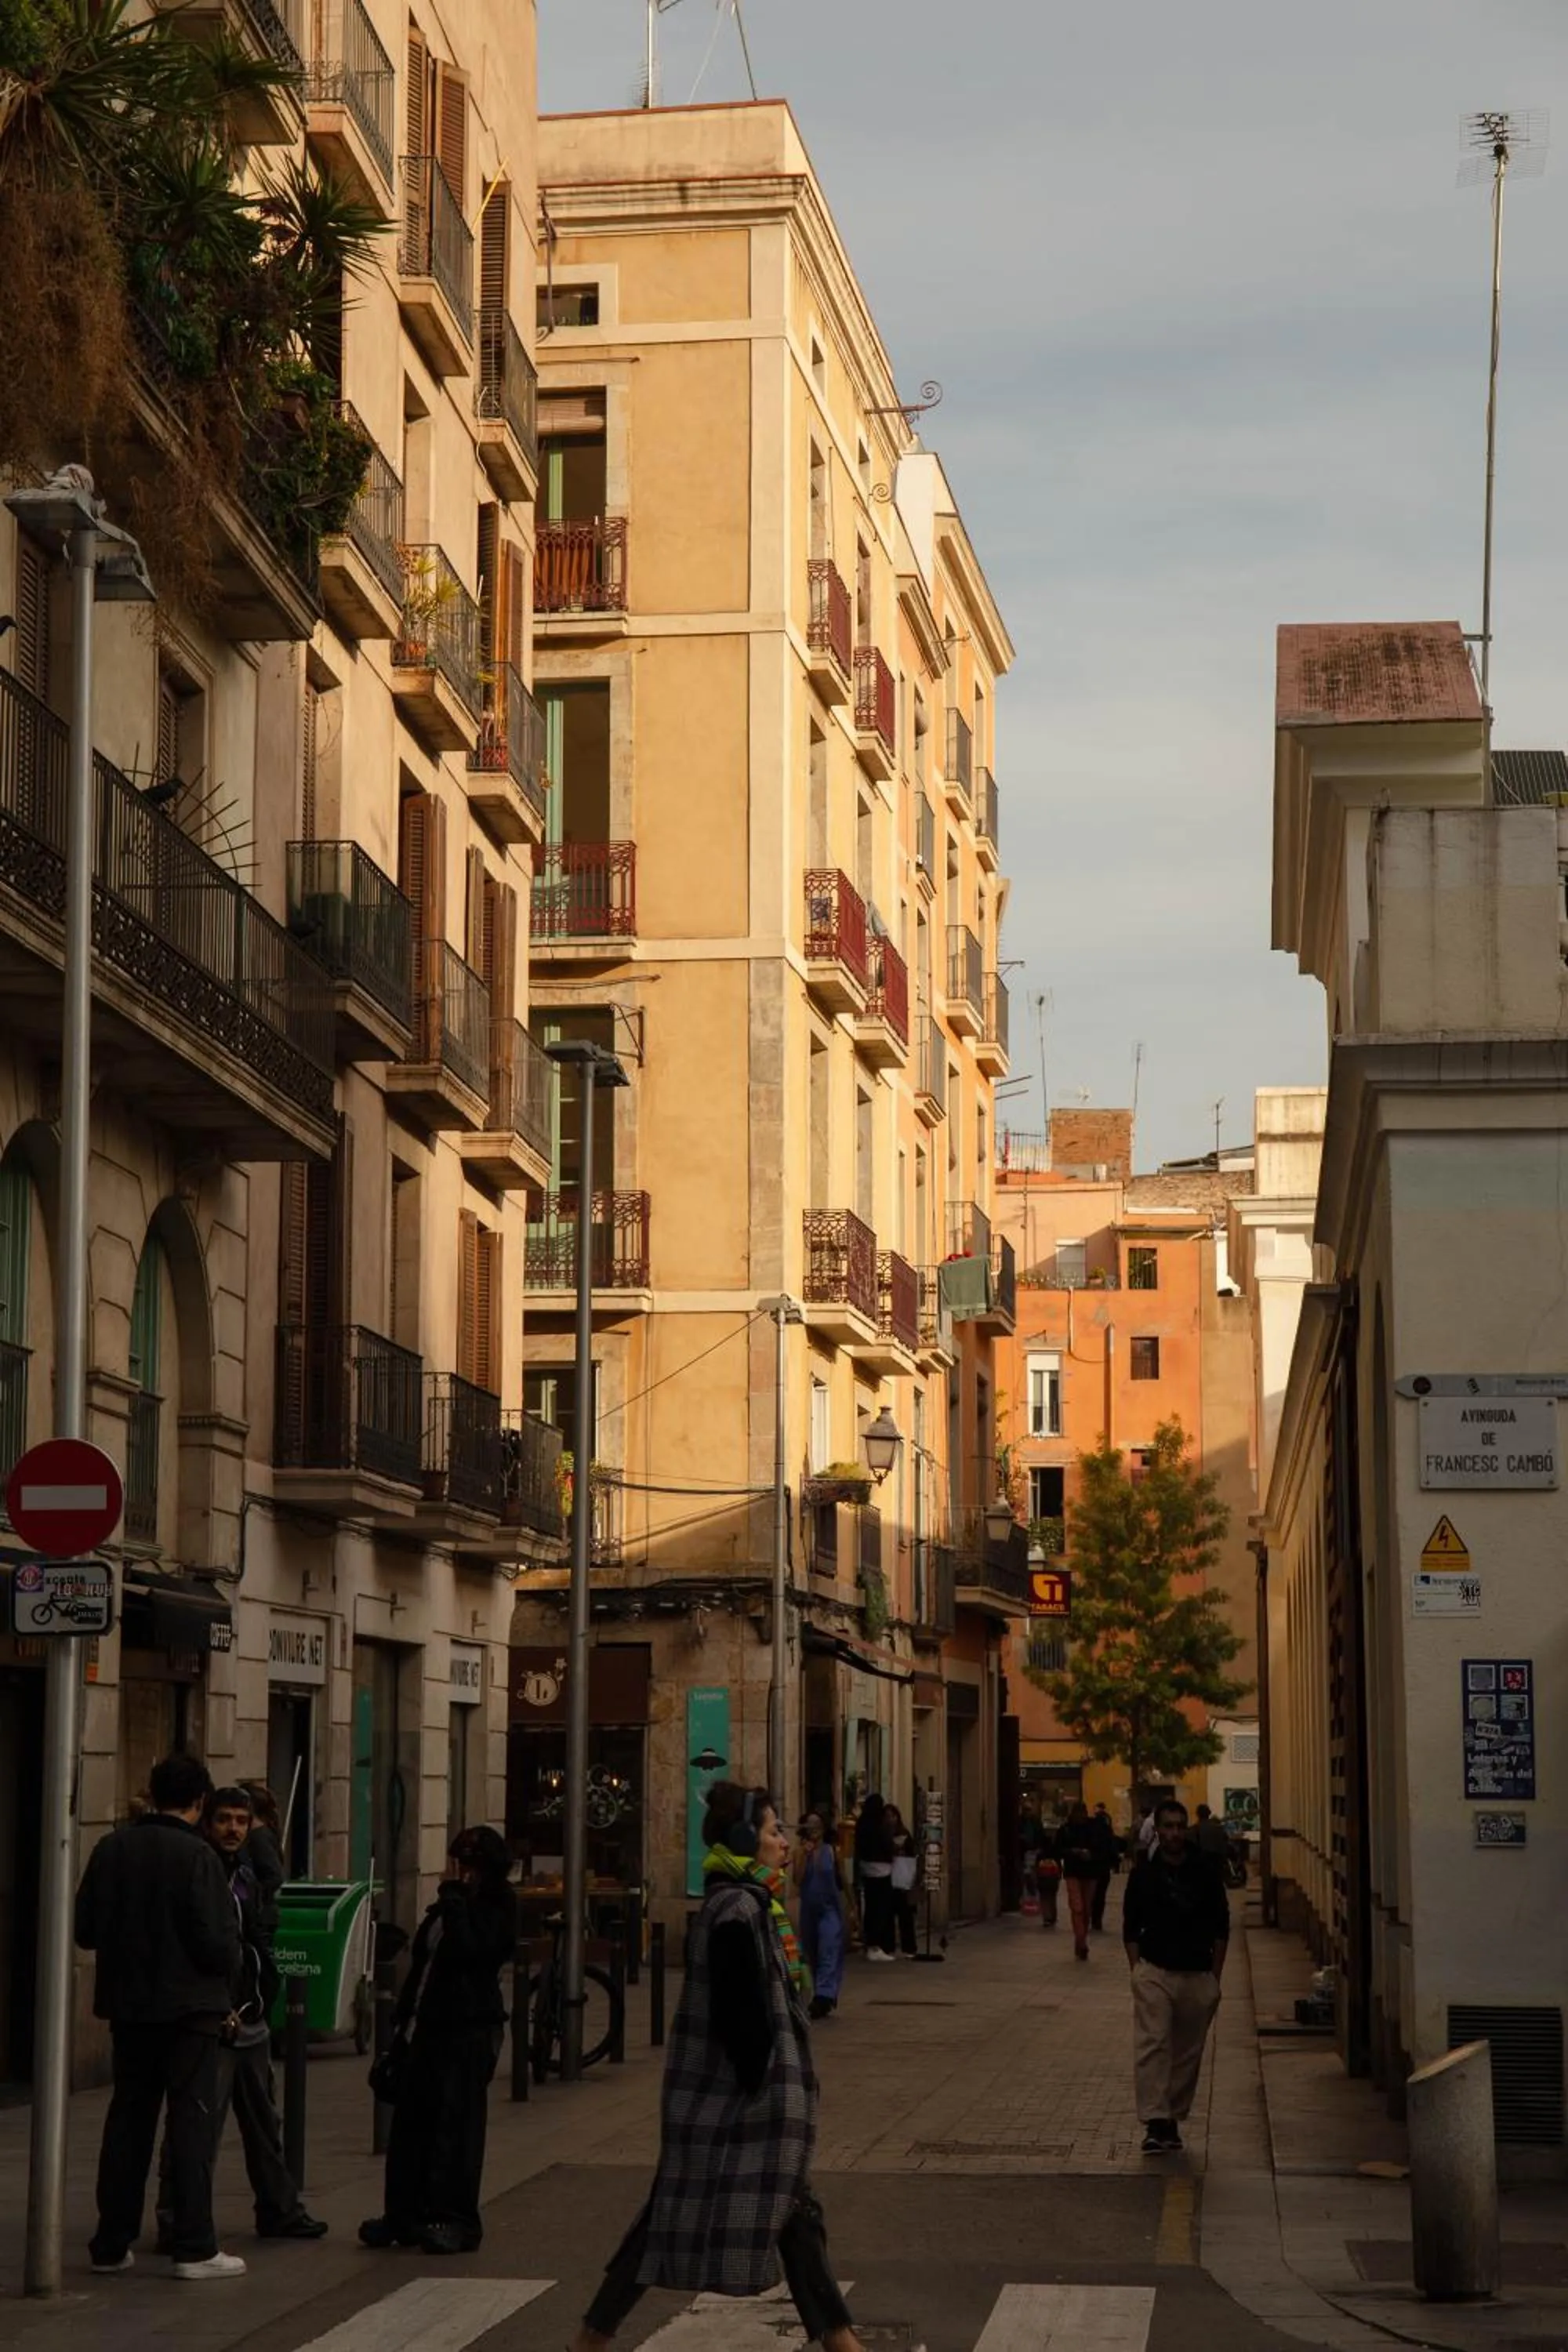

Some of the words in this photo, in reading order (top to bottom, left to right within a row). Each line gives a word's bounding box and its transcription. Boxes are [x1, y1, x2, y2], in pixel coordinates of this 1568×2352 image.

[1461, 1409, 1517, 1424] AVINGUDA
[1481, 1432, 1497, 1446] DE
[1426, 1454, 1499, 1472] FRANCESC
[275, 1946, 307, 1961] idem
[276, 1962, 321, 1976] celona
